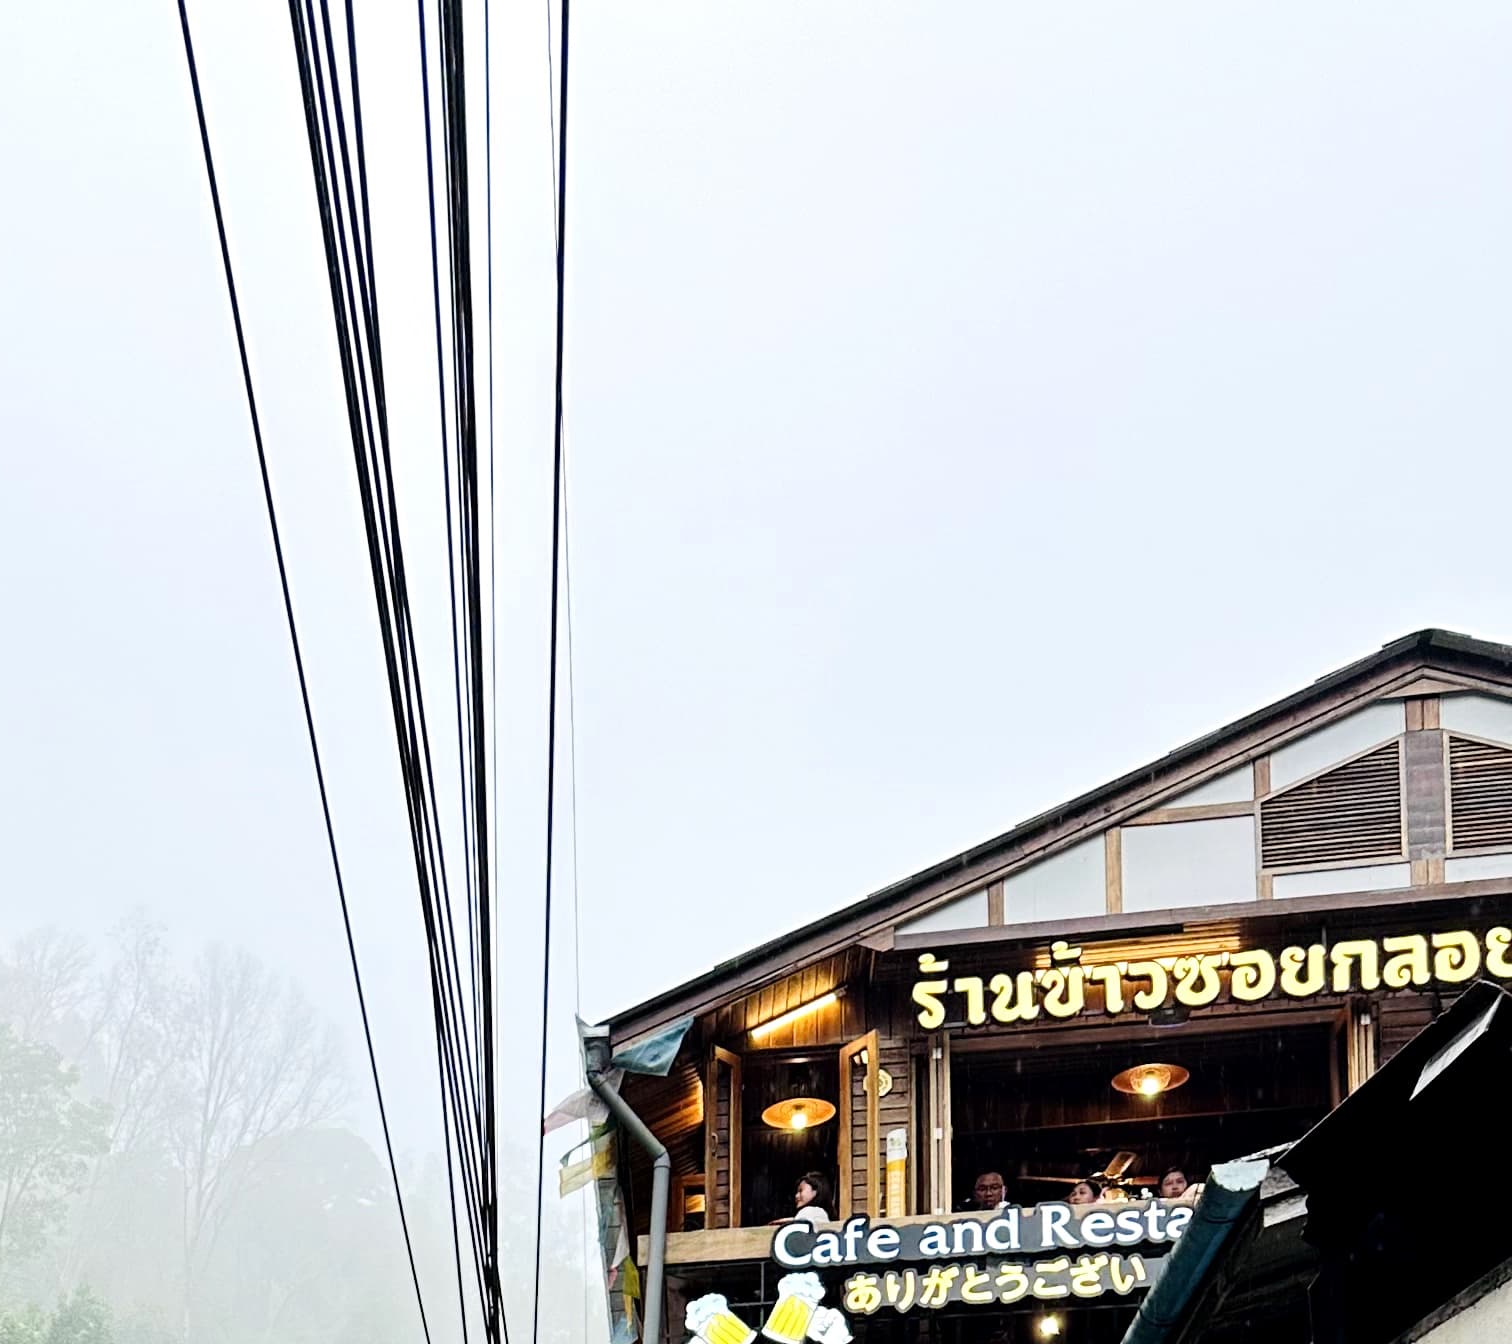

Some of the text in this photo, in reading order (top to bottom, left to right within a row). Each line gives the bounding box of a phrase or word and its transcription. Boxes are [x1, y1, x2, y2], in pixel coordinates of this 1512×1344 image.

[773, 1218, 901, 1266] Cafe
[919, 1208, 1022, 1256] and
[845, 1255, 1146, 1313] ありがとうござい
